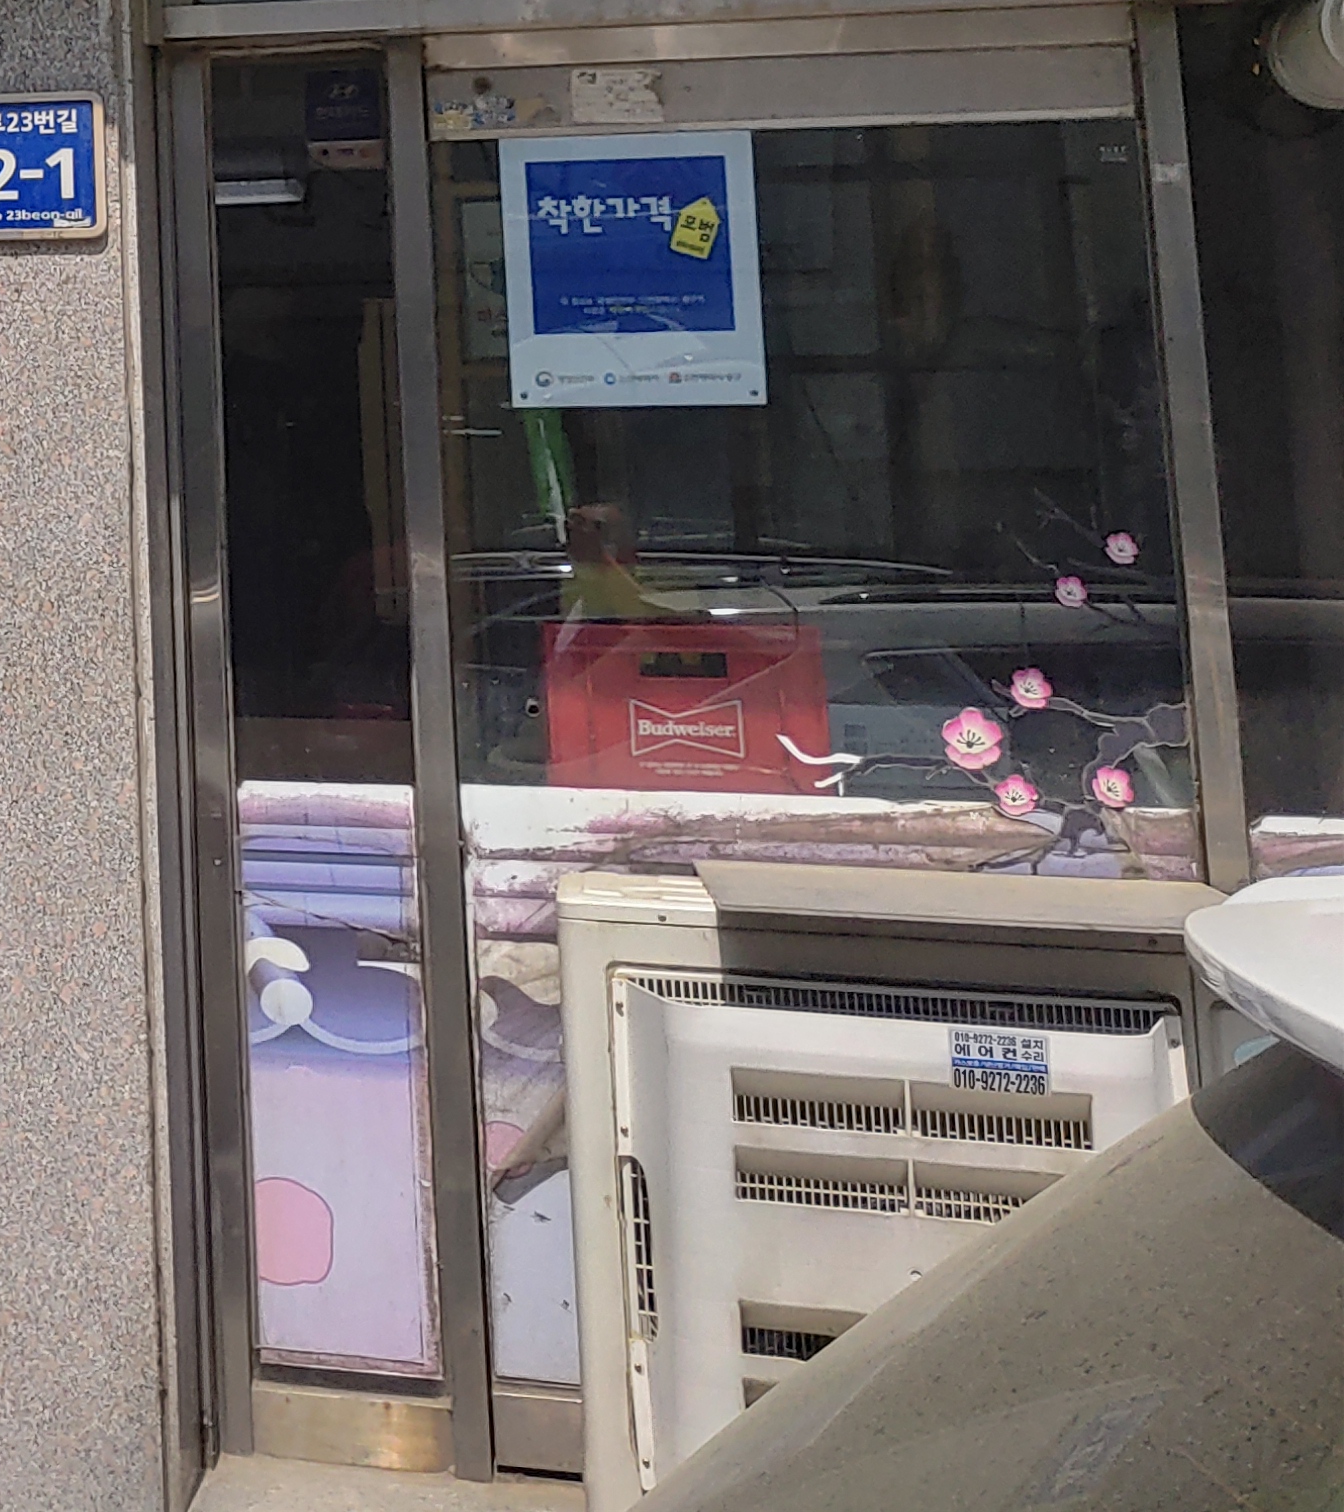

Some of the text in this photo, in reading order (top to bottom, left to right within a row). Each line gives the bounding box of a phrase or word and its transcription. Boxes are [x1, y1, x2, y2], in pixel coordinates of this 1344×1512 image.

[538, 195, 672, 234] 착한가격
[638, 719, 736, 737] Budweiser
[955, 1044, 1044, 1062] 에어컨 수리
[954, 1068, 1045, 1095] 010-9272-2236
